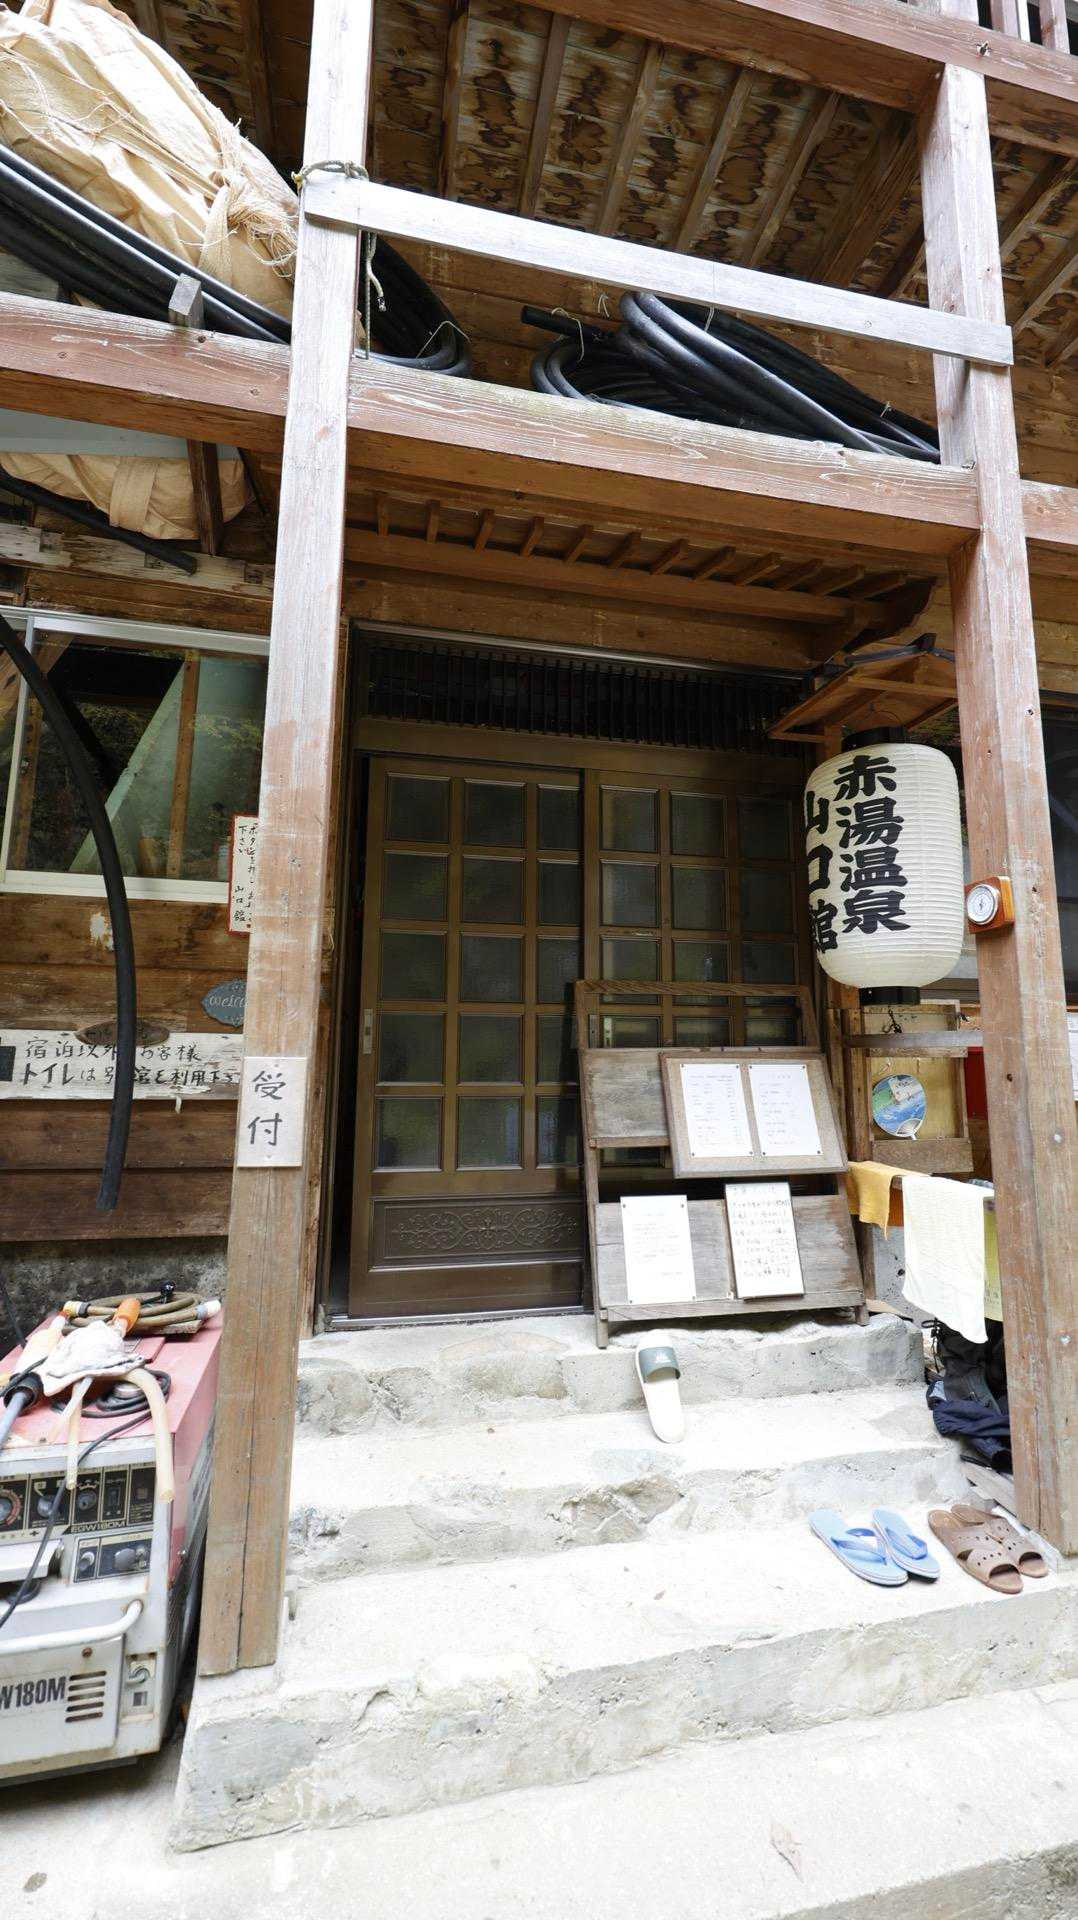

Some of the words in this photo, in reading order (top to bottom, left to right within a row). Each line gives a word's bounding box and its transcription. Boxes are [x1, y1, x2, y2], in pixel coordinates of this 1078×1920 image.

[805, 791, 838, 953] 山口館
[833, 755, 911, 934] 赤湯温泉
[23, 1063, 241, 1086] トイレは別館を利用下さ
[25, 1036, 202, 1062] 宿泊以外お客様
[248, 1071, 286, 1146] 受付
